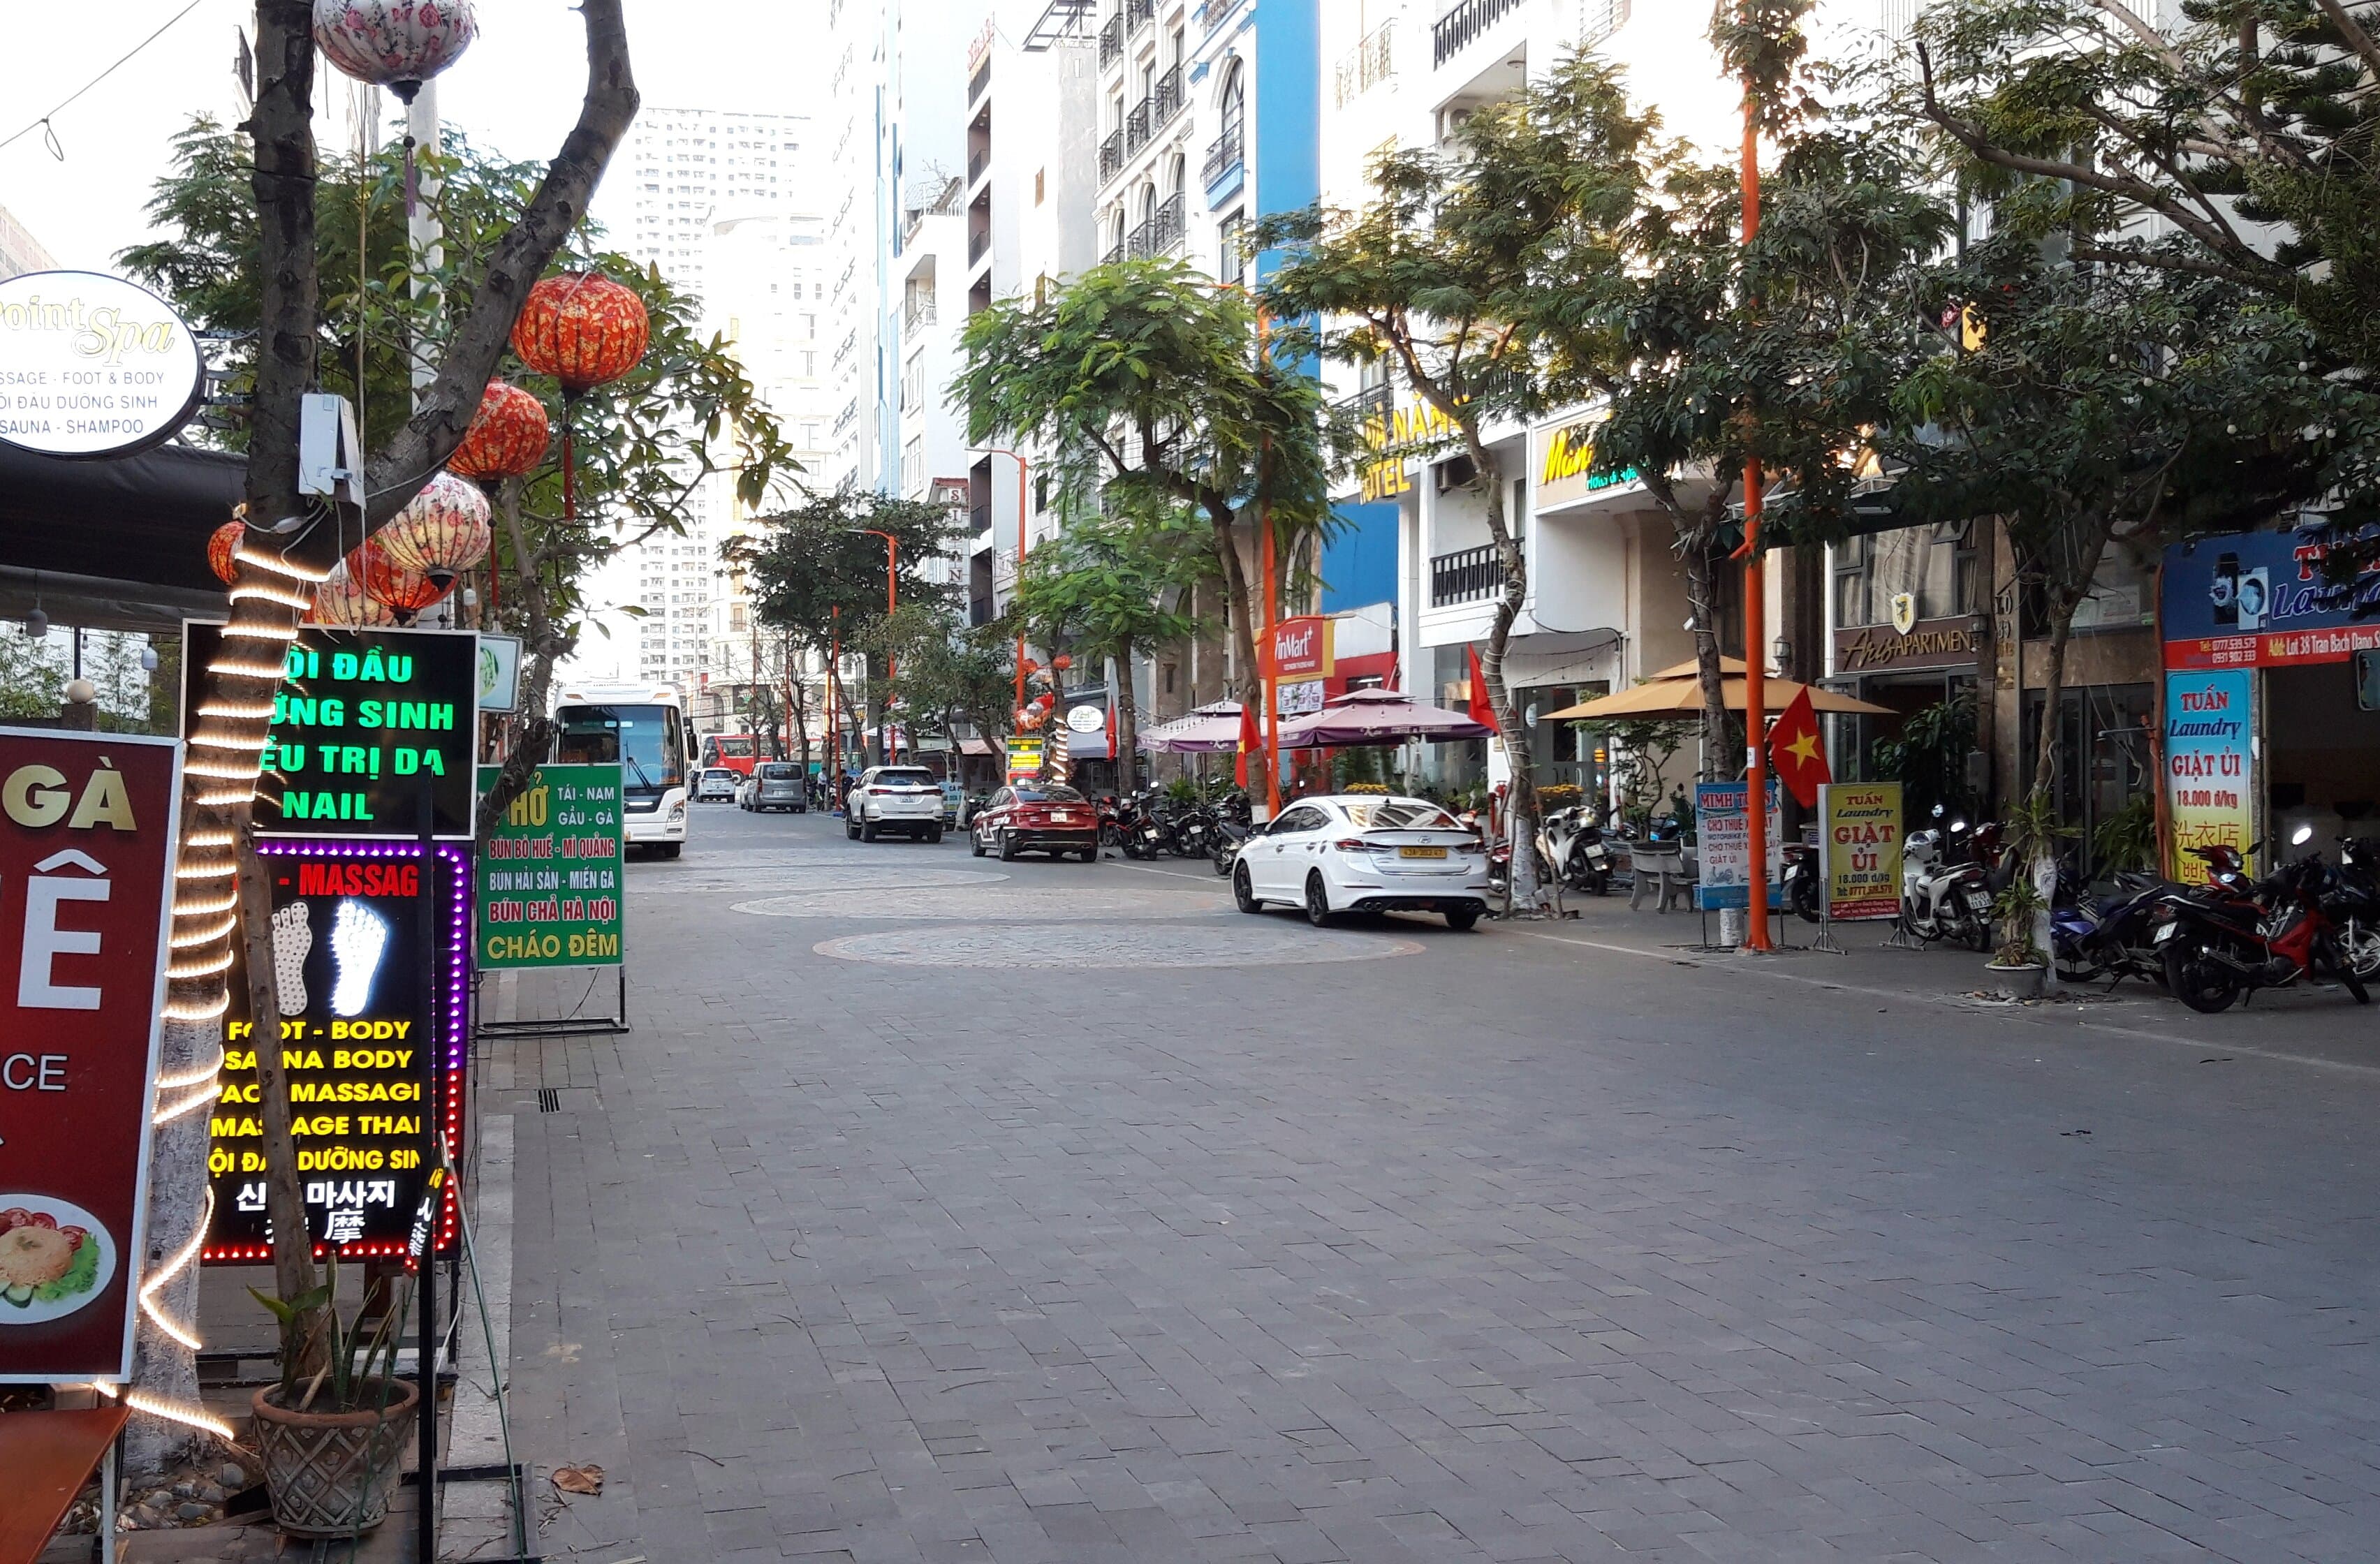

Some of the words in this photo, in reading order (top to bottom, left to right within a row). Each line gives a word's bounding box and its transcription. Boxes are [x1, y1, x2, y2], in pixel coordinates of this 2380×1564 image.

[0, 295, 85, 331] oint
[71, 307, 175, 367] Spa
[63, 371, 101, 385] FOOT
[109, 371, 117, 385] &
[124, 371, 164, 385] BODY
[120, 395, 157, 409] SINH
[0, 420, 51, 434] SAUNA
[66, 419, 144, 434] SHAMPOO
[1895, 630, 1975, 657] APARTMEN
[2286, 637, 2299, 656] Lot
[2312, 635, 2329, 654] Tran
[2330, 633, 2350, 653] Bach
[332, 644, 412, 683] ĐẦU
[2180, 684, 2228, 711] TUẤN
[358, 700, 453, 730] SINH
[2169, 718, 2241, 740] Laundry
[318, 745, 380, 781] TRỊ
[2172, 748, 2215, 782] GIẶT
[2220, 746, 2241, 777] ỦI
[2, 756, 137, 831] GÀ
[283, 791, 374, 820] NAIL
[497, 771, 549, 827] HỞ
[557, 783, 576, 801] TÁI
[587, 786, 615, 804] NẠM
[1846, 792, 1883, 805] TUẤN
[2176, 790, 2210, 807] 18.000
[596, 808, 615, 825] GÀ
[1707, 819, 1722, 832] CHO
[1836, 808, 1893, 818] Laundry
[489, 834, 512, 860] BÚN
[514, 834, 530, 859] BÒ
[531, 832, 554, 859] HUẾ
[562, 834, 577, 859] MÌ
[578, 832, 616, 860] QUẢNG
[1833, 820, 1895, 848] GIẶT
[2173, 820, 2240, 851] 洗衣店
[1708, 843, 1723, 852] CHO
[1851, 846, 1878, 871] ỦI
[489, 868, 512, 891] BÚN
[515, 865, 534, 890] HẢI
[536, 865, 559, 890] SẢN
[569, 864, 597, 890] MIẾN
[600, 866, 615, 889] GÀ
[1838, 873, 1868, 884] 18.000
[489, 897, 522, 922] BÚN
[527, 894, 559, 922] CHẢ
[562, 896, 584, 920] HÀ
[588, 896, 616, 924] NỘI
[487, 929, 561, 959] CHÁO
[568, 927, 617, 957] ĐÊM
[332, 1021, 411, 1040] BODY
[3, 1054, 68, 1091] CE
[224, 1050, 324, 1070] SANA
[334, 1050, 413, 1069] BODY
[290, 1083, 420, 1102] MASSAG
[211, 1116, 348, 1137] MAAGE
[298, 1147, 383, 1171] DƯỠNG
[307, 1180, 395, 1209] 마사지
